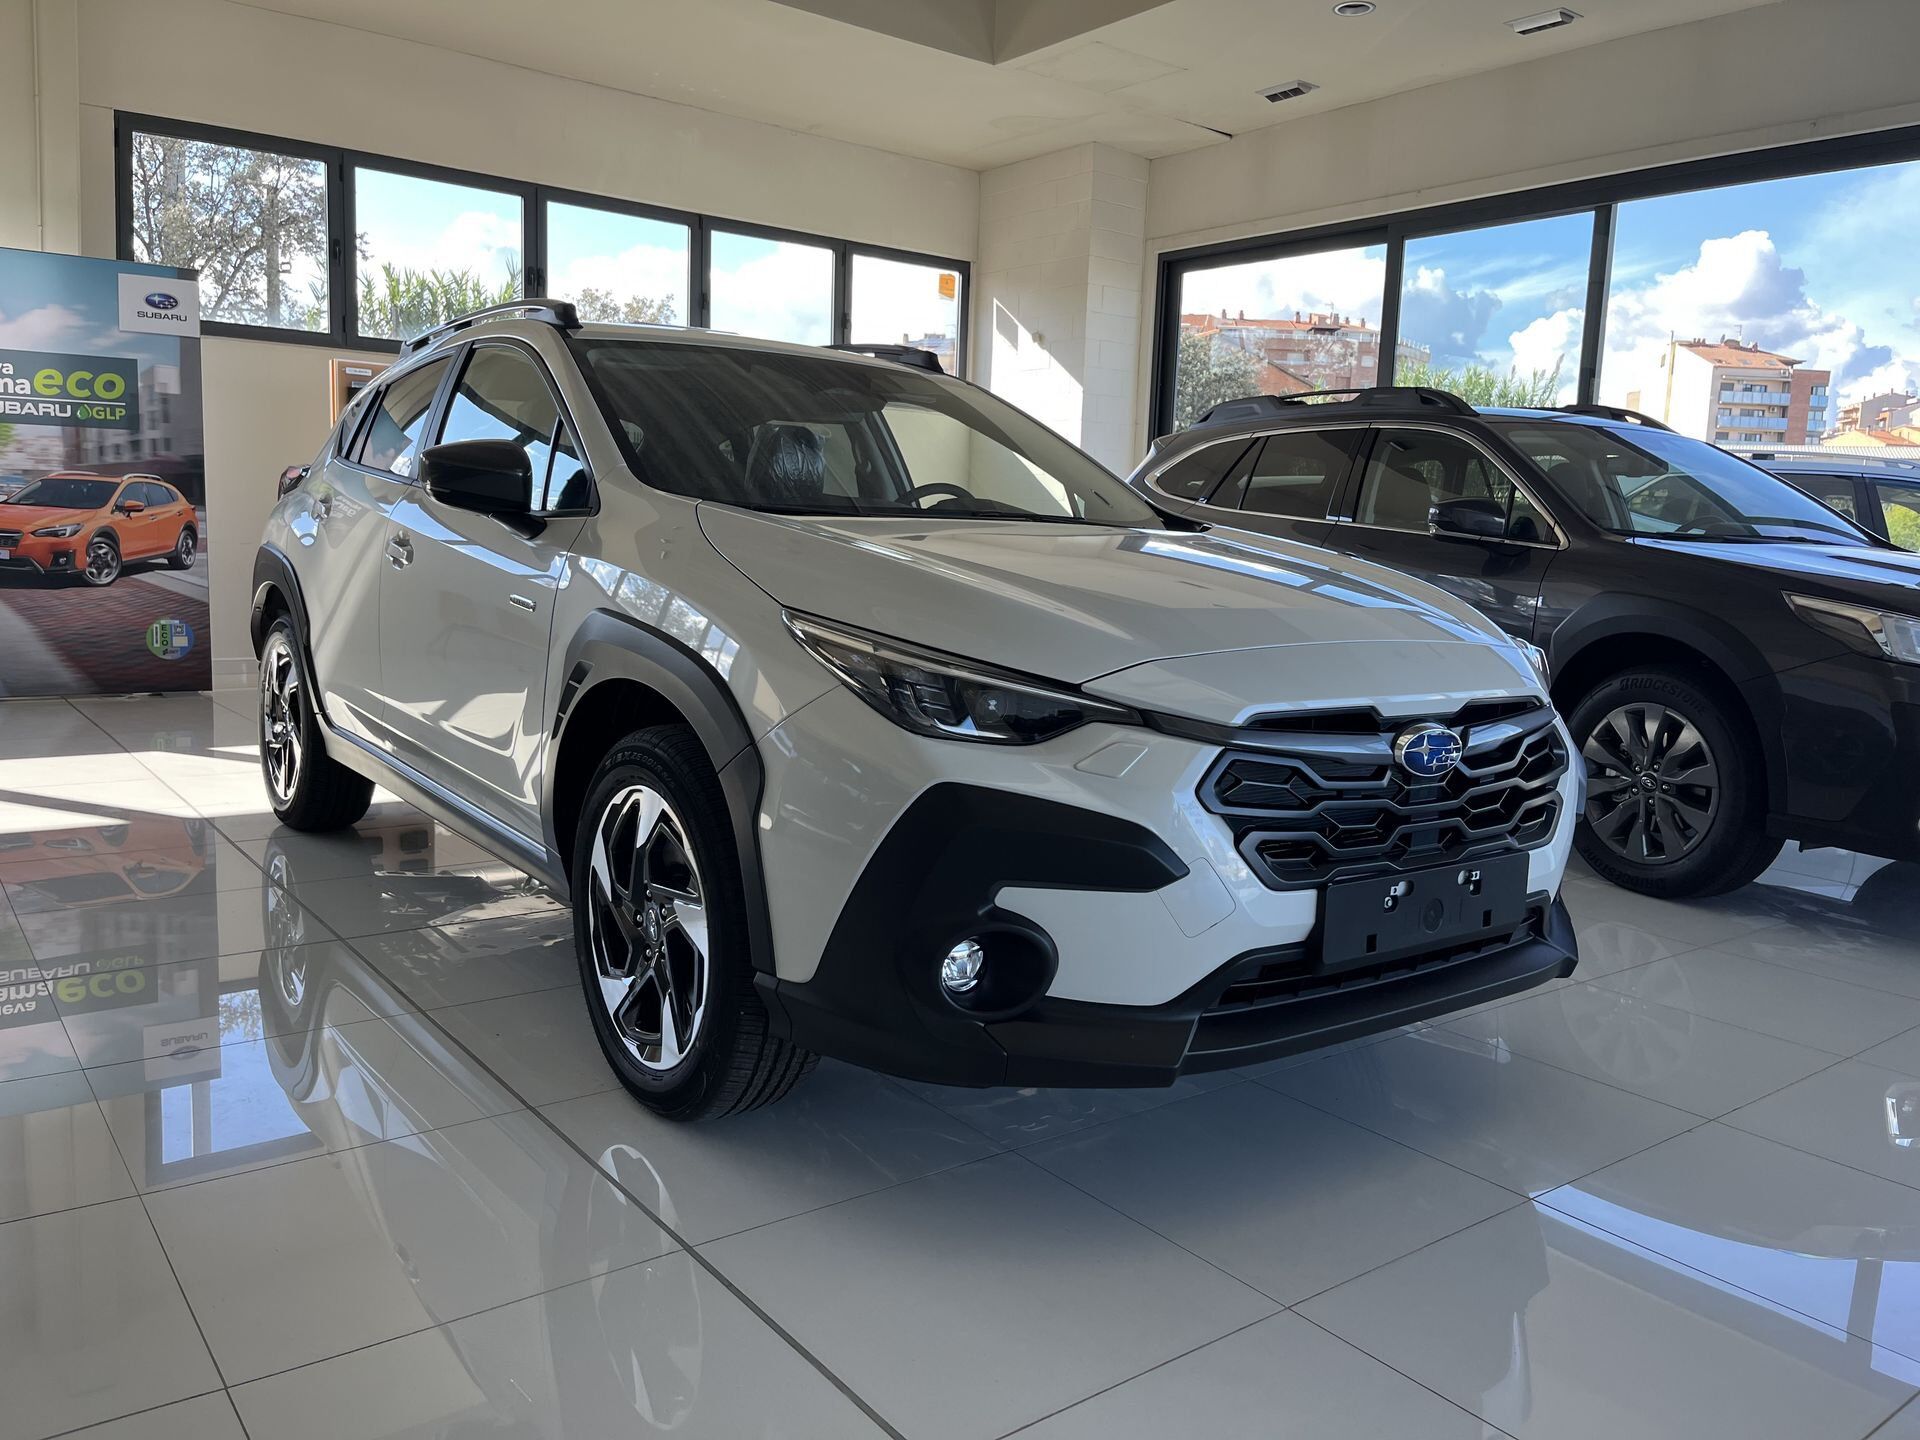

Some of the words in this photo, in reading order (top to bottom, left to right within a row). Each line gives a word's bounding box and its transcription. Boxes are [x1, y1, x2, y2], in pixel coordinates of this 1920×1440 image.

[137, 311, 187, 322] SUBARU
[33, 368, 126, 400] eco
[0, 401, 72, 418] BARU
[92, 406, 126, 421] GLP
